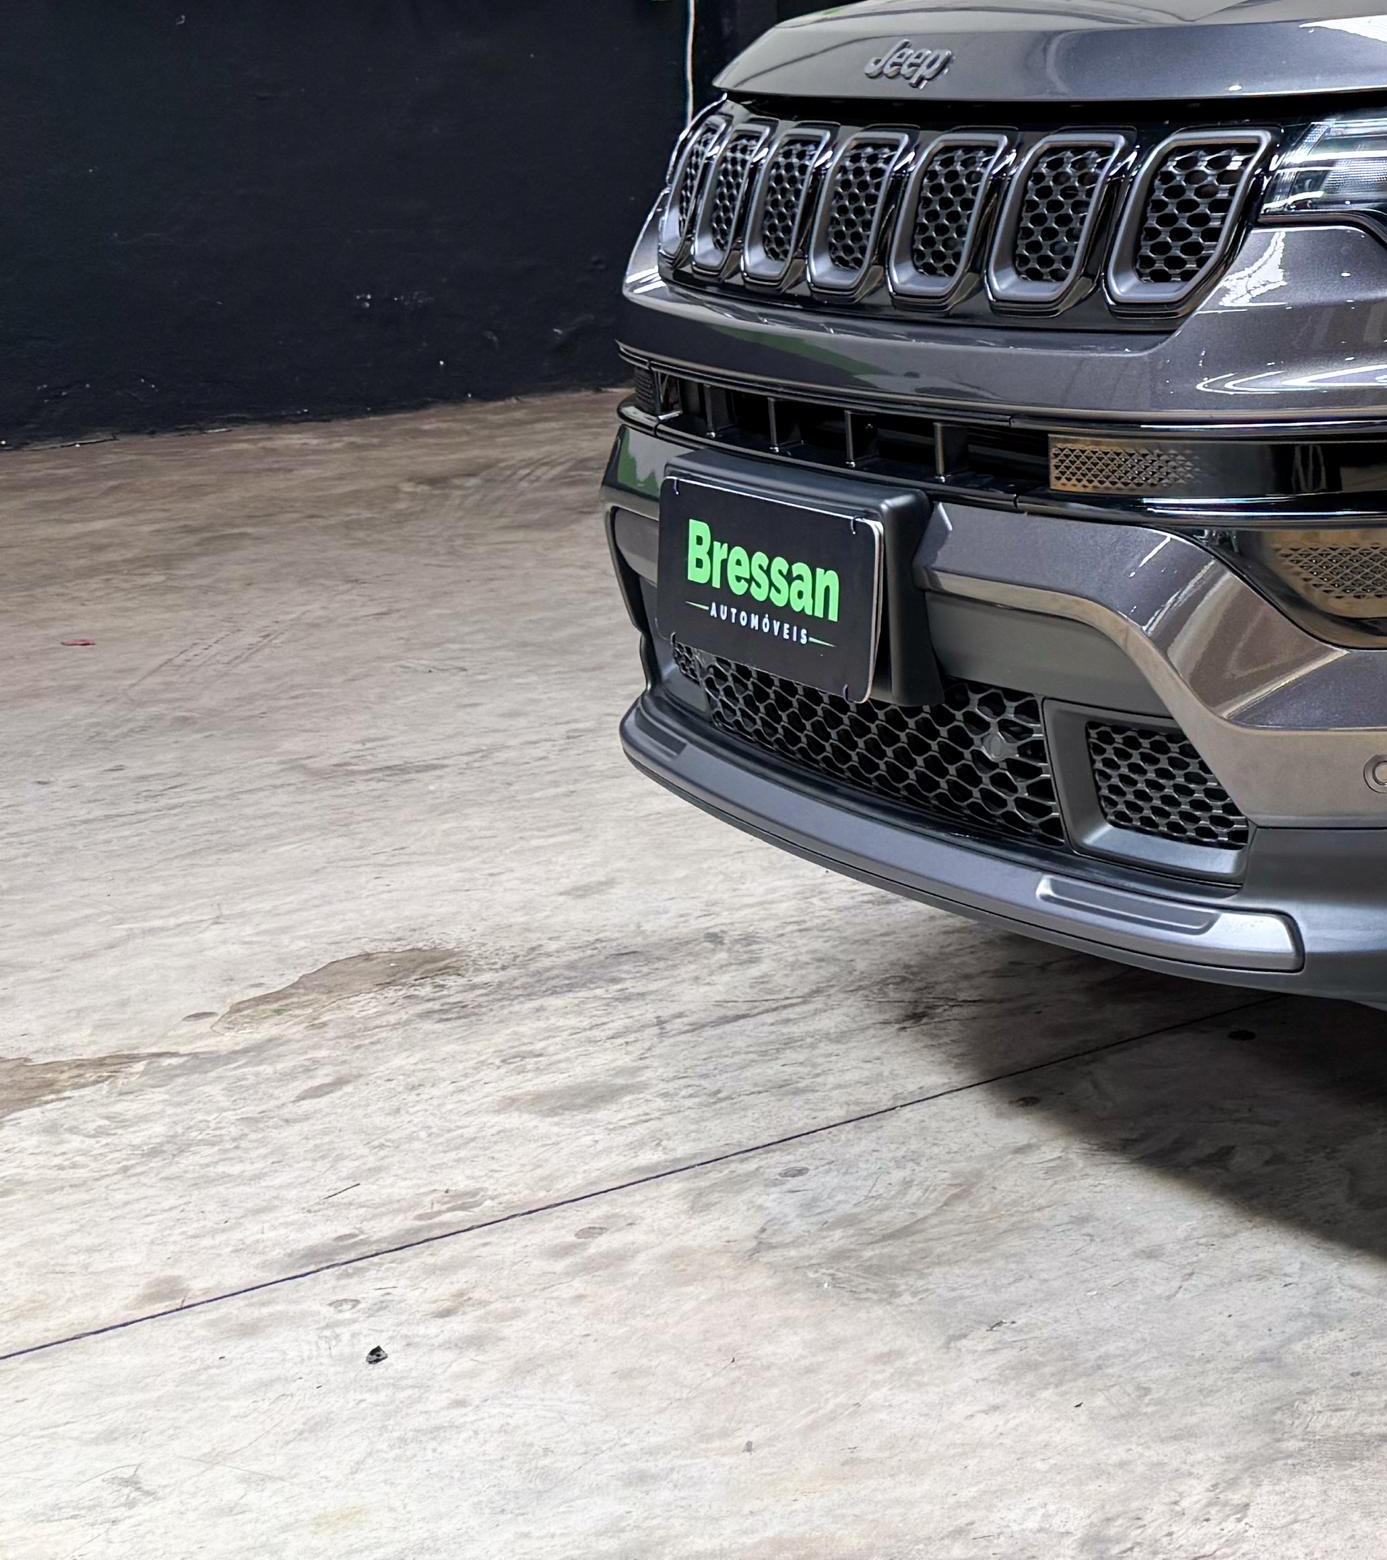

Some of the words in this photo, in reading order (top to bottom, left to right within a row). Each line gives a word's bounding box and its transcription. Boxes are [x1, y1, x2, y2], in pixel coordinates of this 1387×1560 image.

[863, 38, 952, 88] Jeep
[687, 518, 840, 622] Bressan
[709, 602, 809, 645] AUTOMÓVEIS
